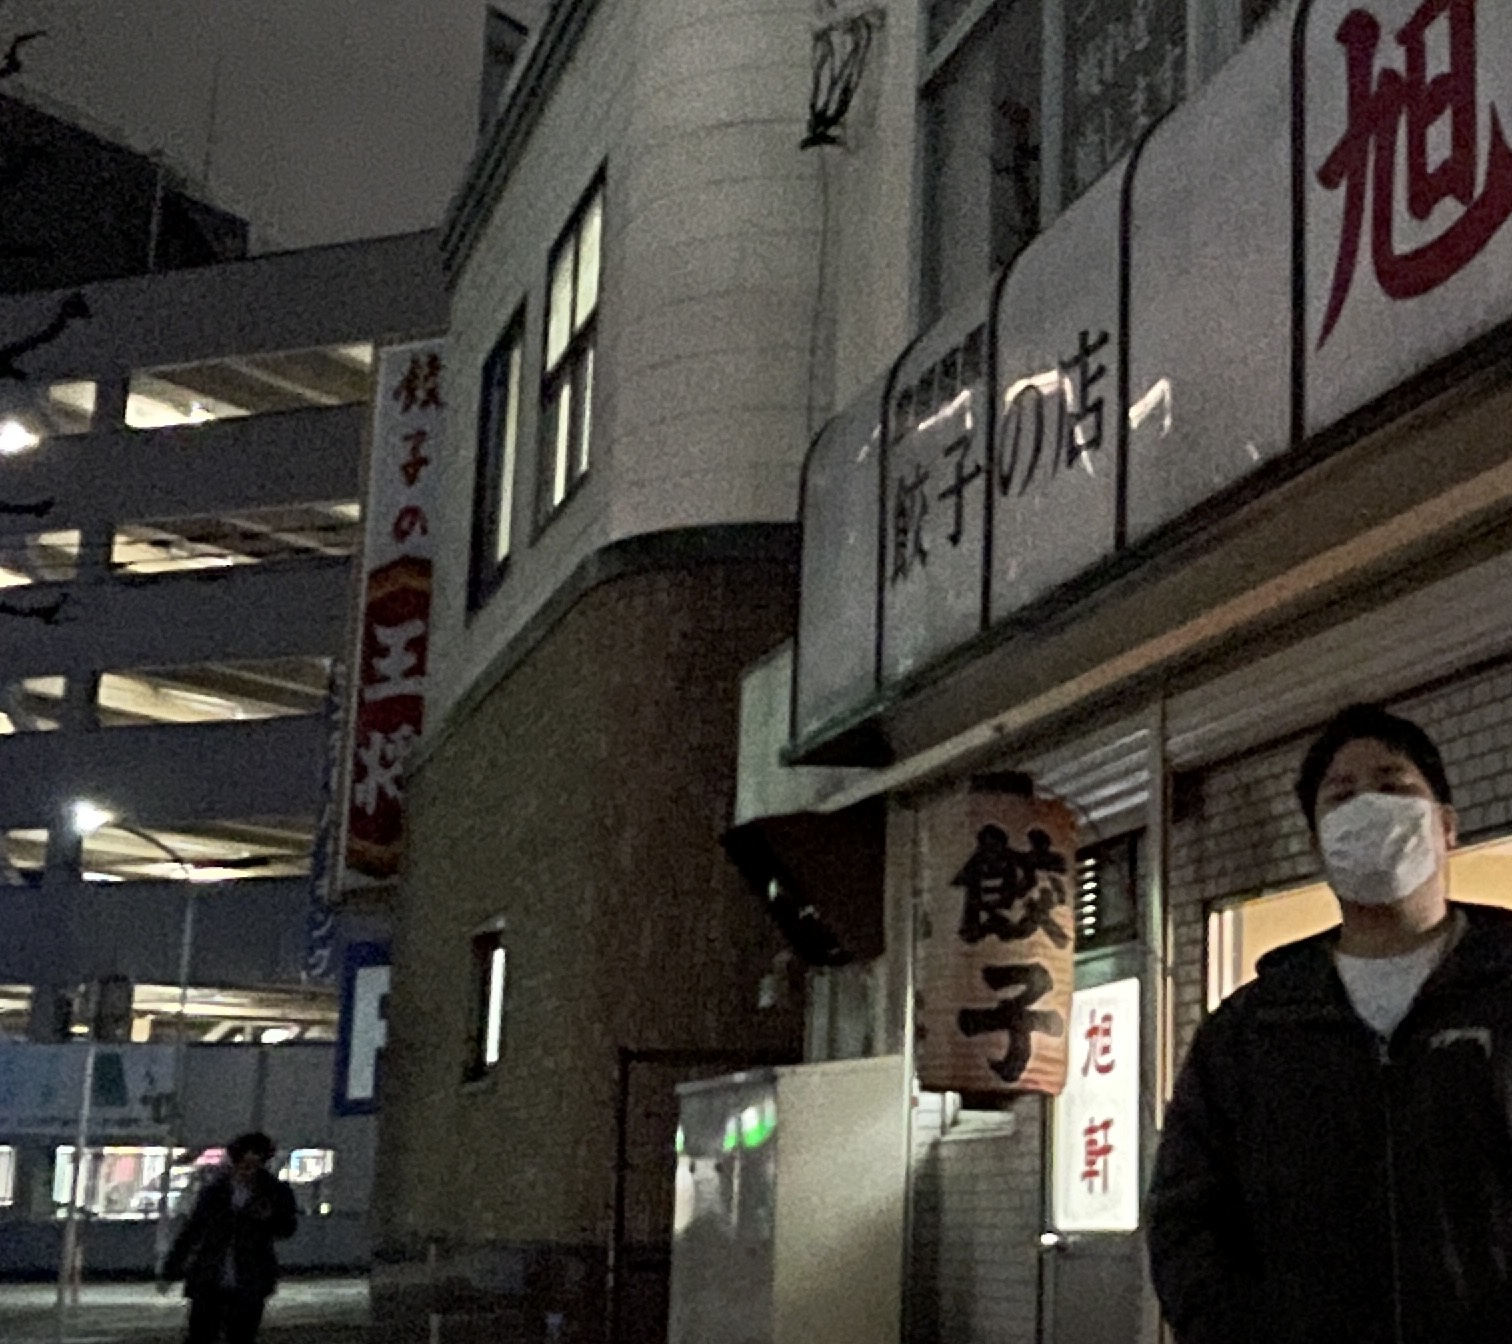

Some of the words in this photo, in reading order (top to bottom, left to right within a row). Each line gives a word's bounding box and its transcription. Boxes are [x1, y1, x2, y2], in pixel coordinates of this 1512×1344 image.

[889, 328, 1109, 584] 餃子の店
[952, 822, 1072, 1084] 餃子
